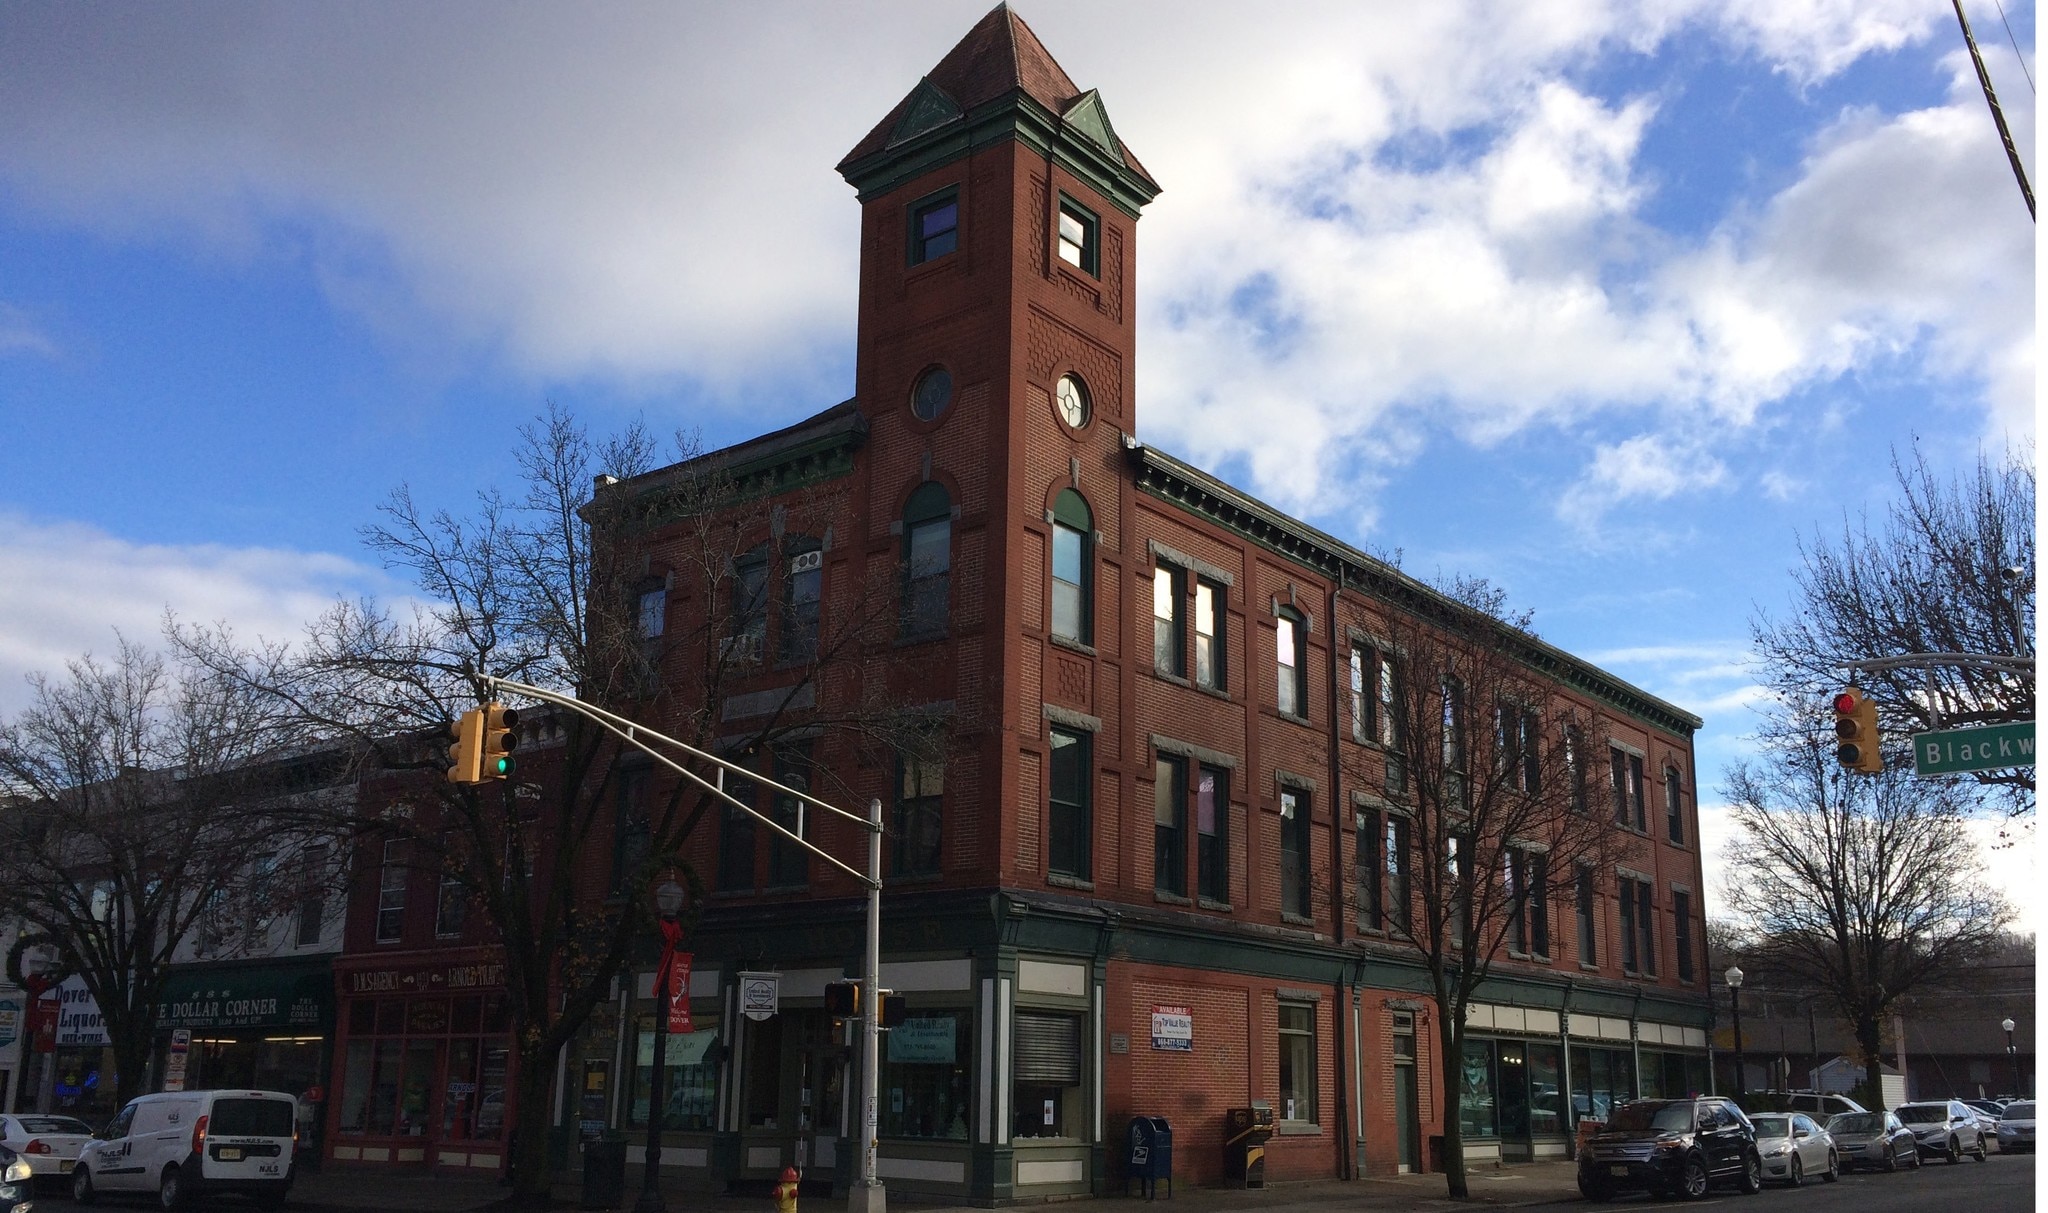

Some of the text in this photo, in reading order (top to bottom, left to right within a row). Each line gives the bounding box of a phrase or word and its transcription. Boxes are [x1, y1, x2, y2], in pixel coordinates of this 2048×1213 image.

[55, 984, 91, 1003] Dover
[172, 1001, 219, 1018] DOLLAR
[225, 998, 277, 1015] CORNER
[1159, 1006, 1187, 1015] AVAILABLE
[259, 1165, 279, 1173] NJLS
